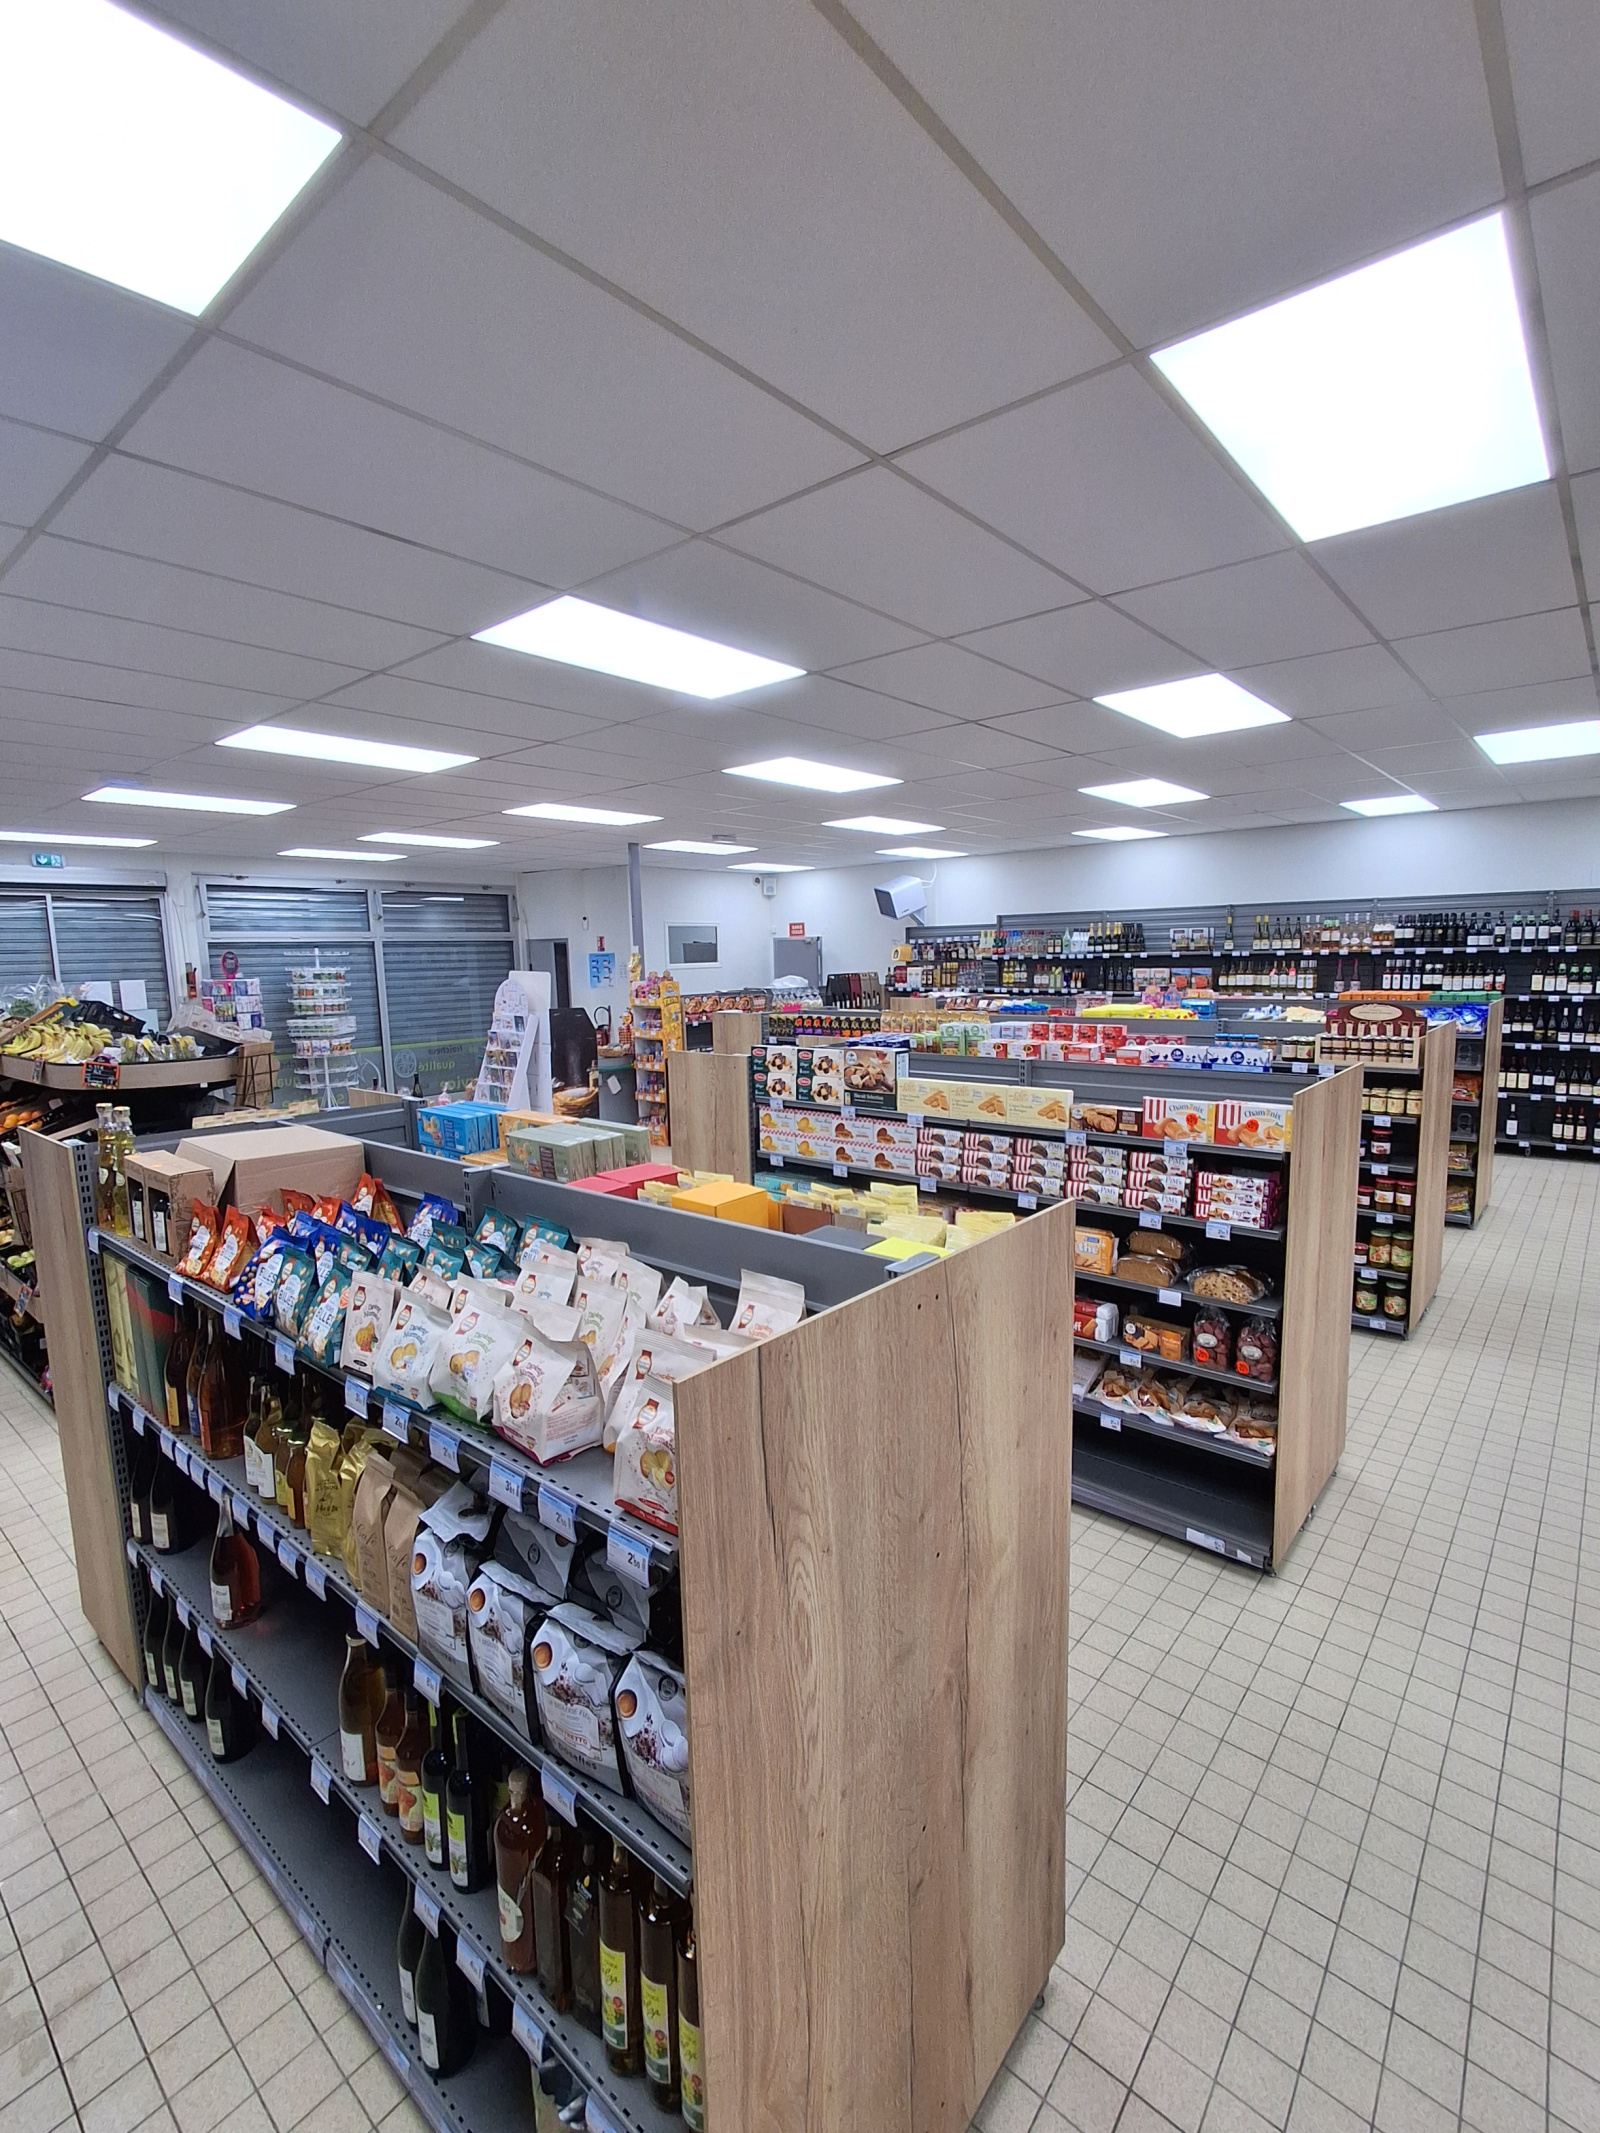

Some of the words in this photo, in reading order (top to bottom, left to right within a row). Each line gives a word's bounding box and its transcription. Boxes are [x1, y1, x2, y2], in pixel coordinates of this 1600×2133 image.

[1144, 1098, 1166, 1123] LU
[1218, 1103, 1240, 1130] LU
[920, 1128, 933, 1143] LU
[965, 1133, 979, 1149] LU
[918, 1143, 932, 1160] LU
[1017, 1138, 1033, 1156] LU
[1071, 1145, 1088, 1162] LU
[964, 1150, 978, 1167] LU
[1015, 1156, 1032, 1174] LU
[1131, 1152, 1151, 1171] LU
[1168, 1157, 1185, 1166] PiM's
[918, 1160, 931, 1176] LU
[962, 1167, 977, 1184] LU
[1072, 1162, 1089, 1181] LU
[1012, 1174, 1029, 1192] LU
[1129, 1171, 1149, 1190] LU
[1165, 1176, 1182, 1185] PiM's
[1198, 1172, 1213, 1188] LU
[1066, 1180, 1084, 1199] LU
[1197, 1189, 1212, 1202] LU
[1125, 1189, 1145, 1209] LU
[1161, 1194, 1178, 1204] PiM's
[1195, 1203, 1209, 1218] LU
